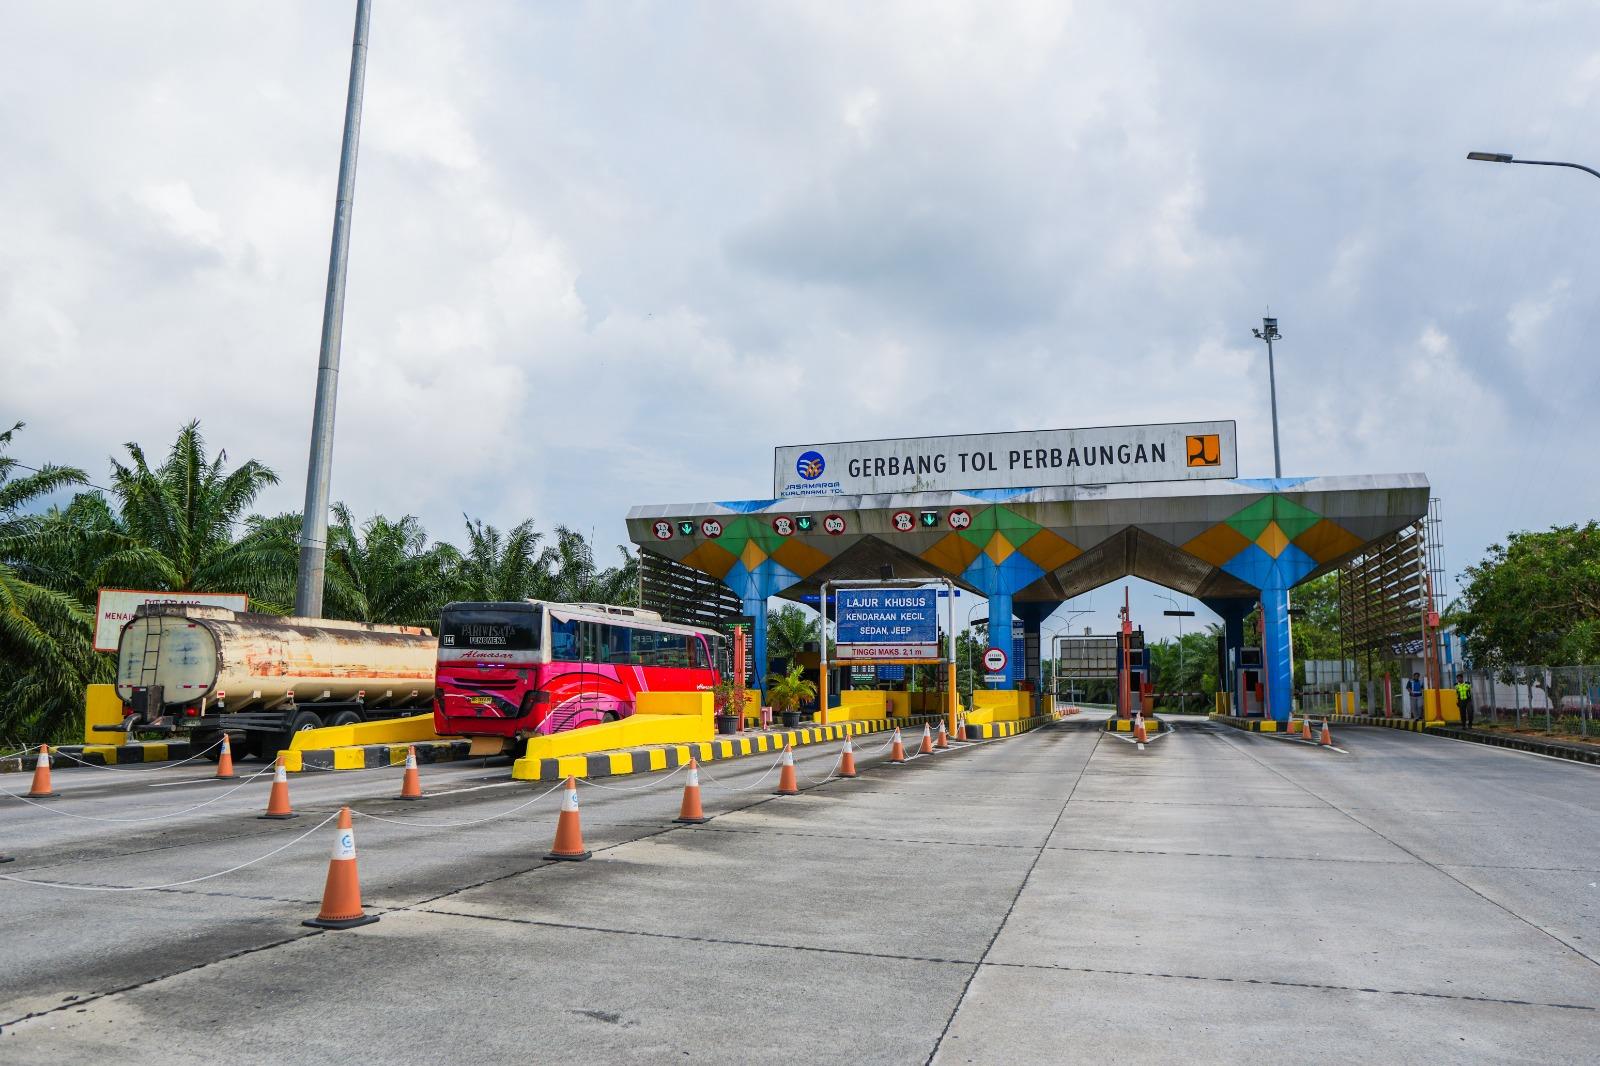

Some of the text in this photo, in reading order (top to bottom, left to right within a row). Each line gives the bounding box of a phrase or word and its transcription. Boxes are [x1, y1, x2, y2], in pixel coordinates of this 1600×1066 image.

[848, 443, 1166, 478] GERBANG TOL PERBAUNGAN
[784, 482, 840, 490] JASAMARGA
[846, 598, 926, 608] LAJUR KHUSUS
[860, 627, 889, 635] SEDAN,
